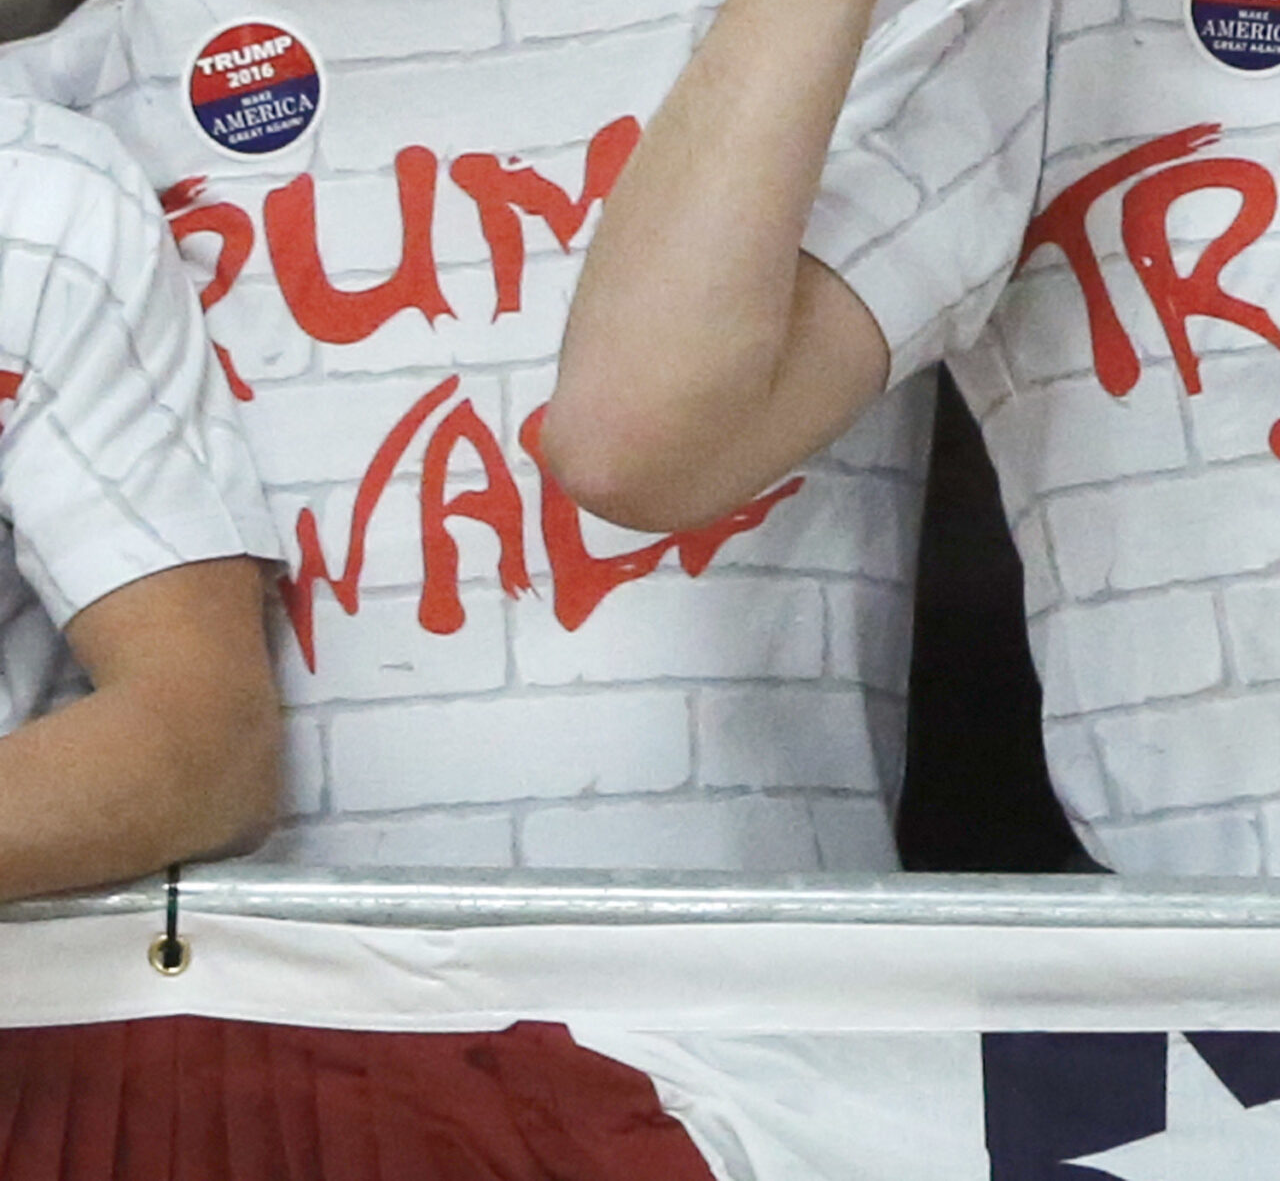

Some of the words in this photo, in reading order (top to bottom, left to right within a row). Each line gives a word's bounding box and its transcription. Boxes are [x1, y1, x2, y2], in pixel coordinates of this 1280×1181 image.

[1238, 9, 1270, 21] MAKE
[195, 35, 294, 76] TRUMP
[226, 62, 276, 89] 2016
[212, 92, 315, 136] AMERICA
[160, 115, 645, 402] RUM
